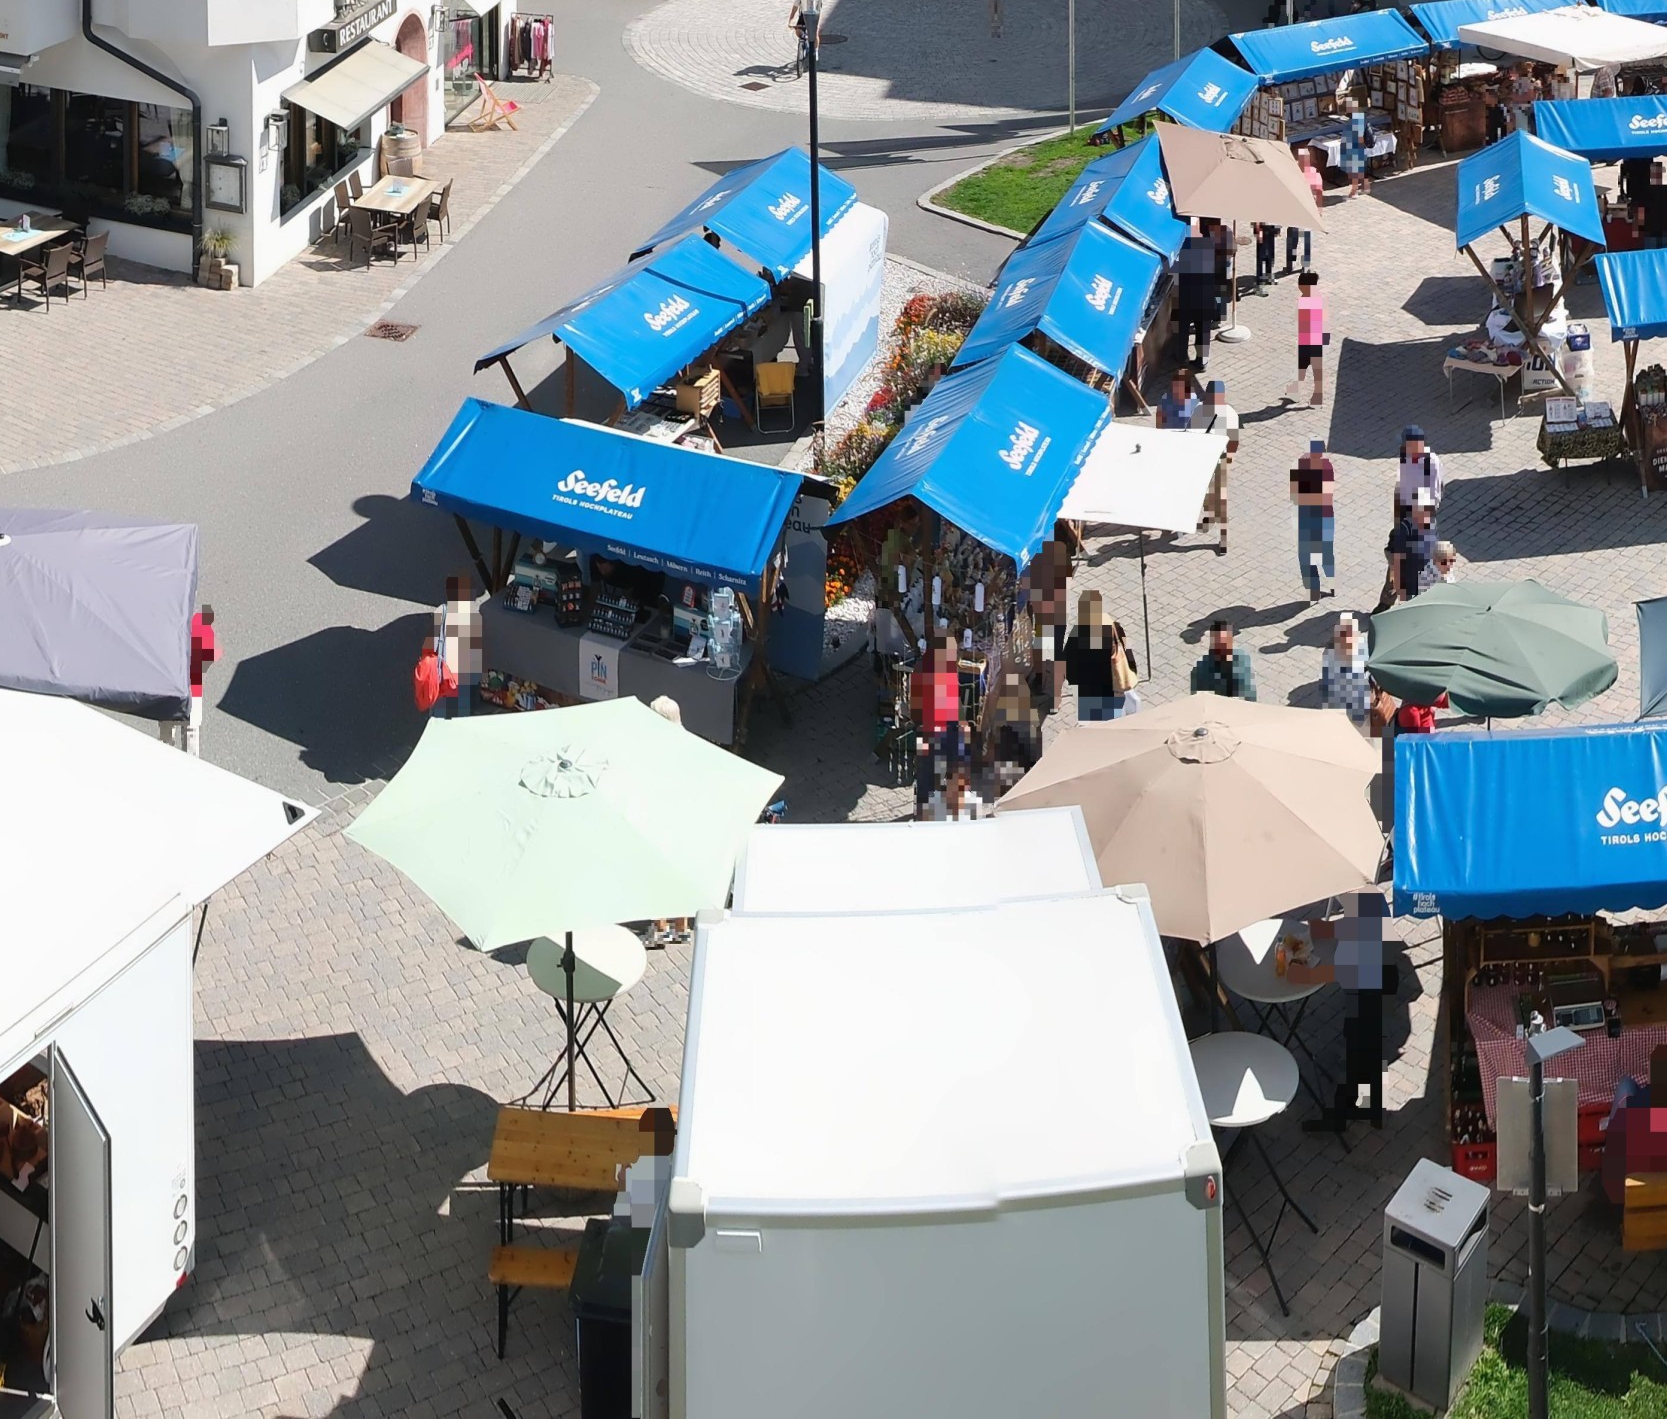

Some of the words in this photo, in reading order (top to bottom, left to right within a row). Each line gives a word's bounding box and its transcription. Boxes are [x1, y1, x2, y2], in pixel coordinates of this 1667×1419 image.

[644, 293, 690, 331] Seefeld
[557, 469, 648, 509] Seefeld
[552, 493, 579, 507] TIROLS
[579, 500, 634, 521] HOCHPLATEAU
[633, 549, 659, 565] Leutasch
[695, 567, 712, 579] Reith
[1600, 832, 1641, 846] TIROLS
